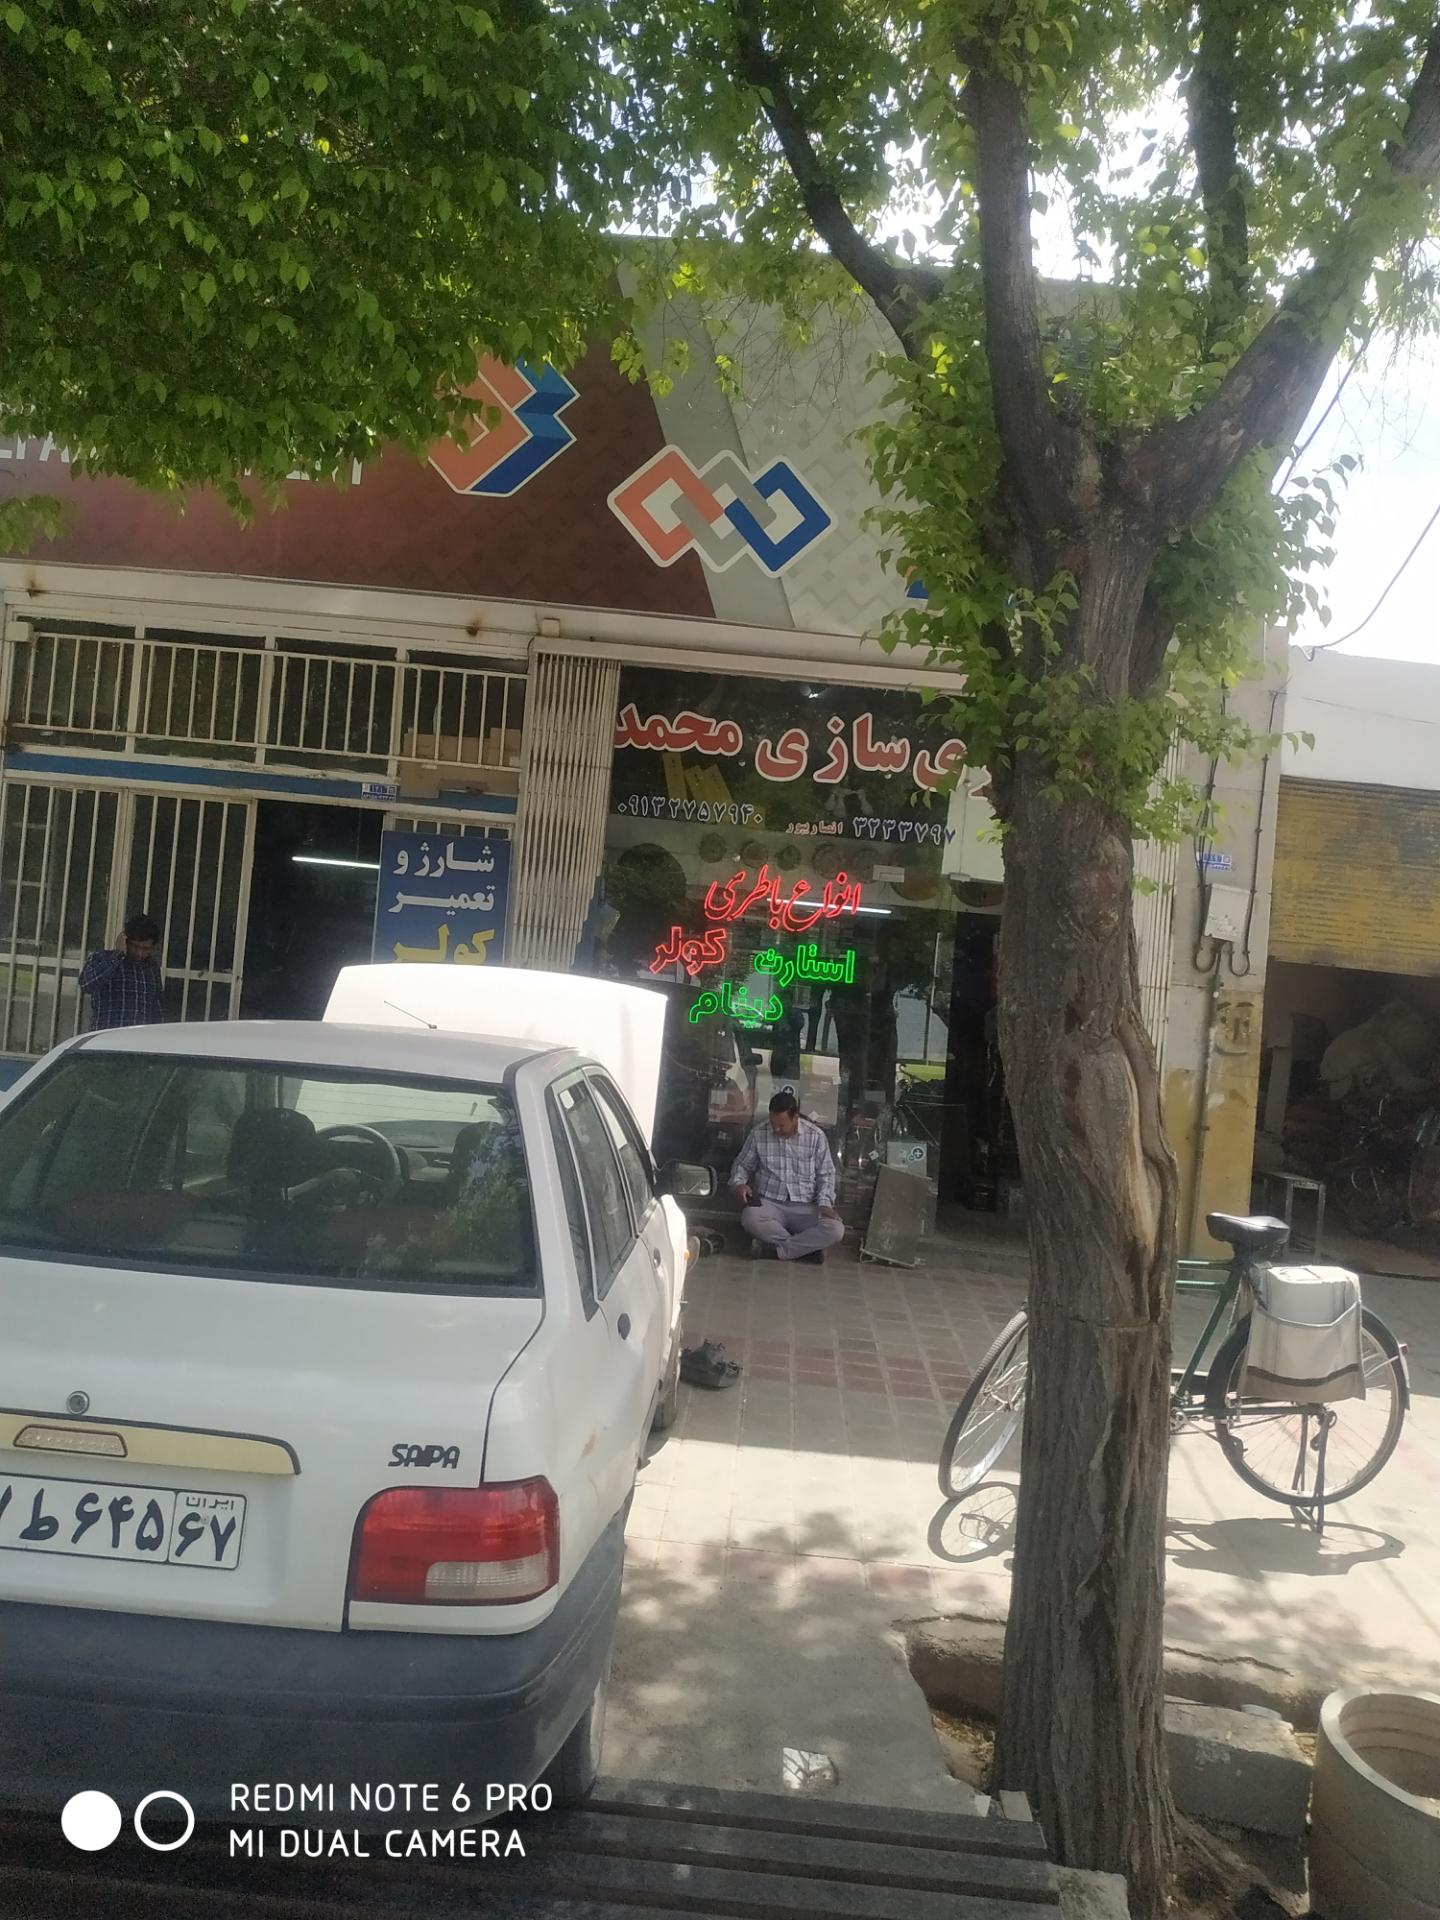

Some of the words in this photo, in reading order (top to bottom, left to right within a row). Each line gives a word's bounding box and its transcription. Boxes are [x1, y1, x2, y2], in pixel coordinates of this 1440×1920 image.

[614, 703, 743, 757] محمد
[754, 712, 910, 784] سازی
[392, 849, 410, 875] و
[414, 841, 495, 878] شارژ
[388, 885, 497, 917] تعمیر
[704, 864, 787, 930] باطری
[782, 872, 862, 932] انواع
[391, 923, 496, 965] کولر
[649, 926, 728, 976] کولر
[754, 944, 856, 988] استارت
[689, 982, 784, 1029] دینام
[388, 1443, 460, 1469] SAIPA
[186, 1495, 235, 1511] ایران
[175, 1511, 236, 1561] ۶۷
